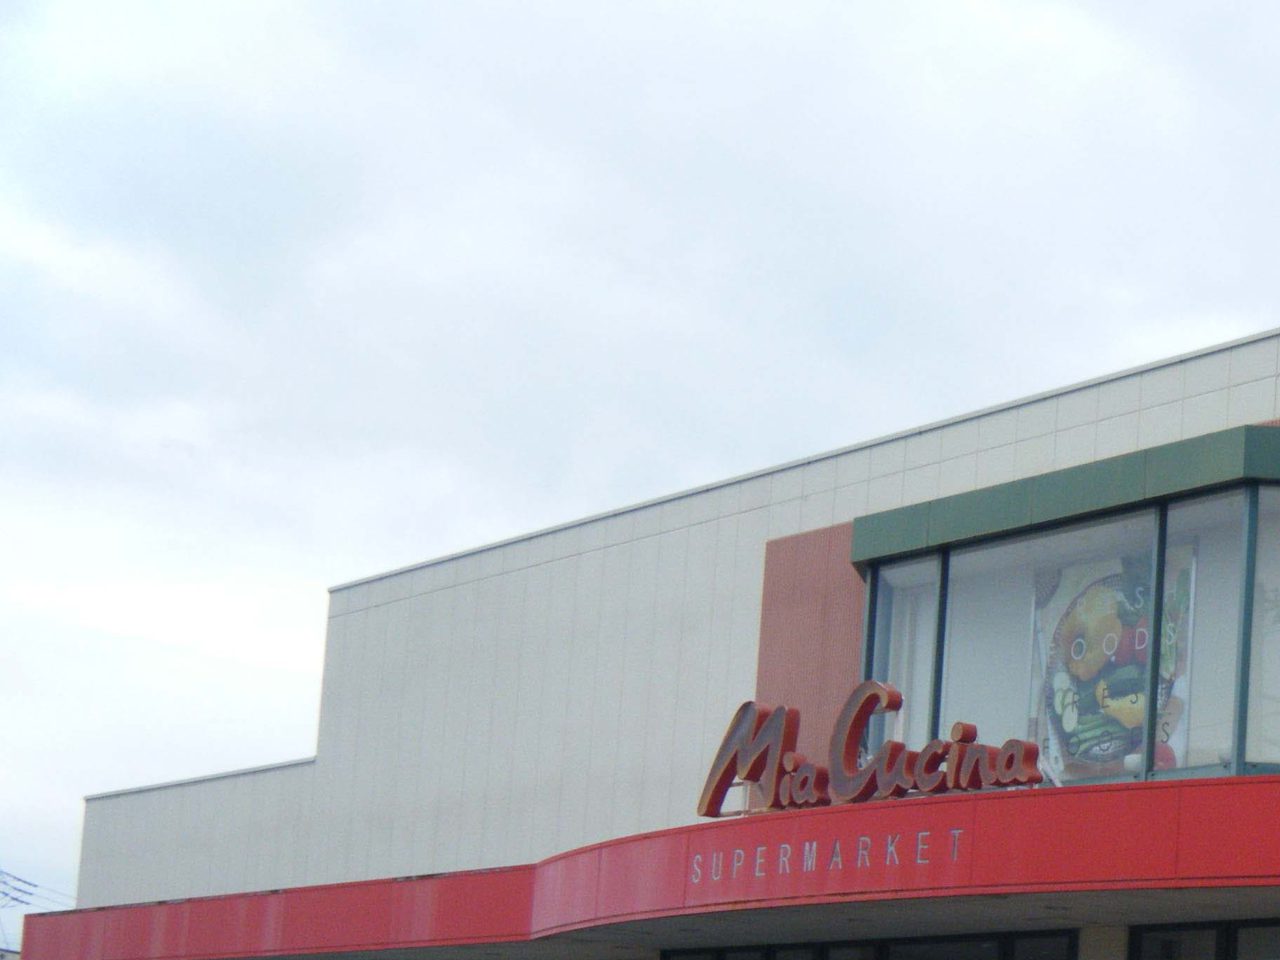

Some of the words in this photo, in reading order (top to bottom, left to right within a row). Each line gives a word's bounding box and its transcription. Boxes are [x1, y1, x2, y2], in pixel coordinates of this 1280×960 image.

[697, 701, 831, 817] Mia
[829, 679, 1044, 801] Cucina
[690, 827, 964, 884] SUPERMARKET
